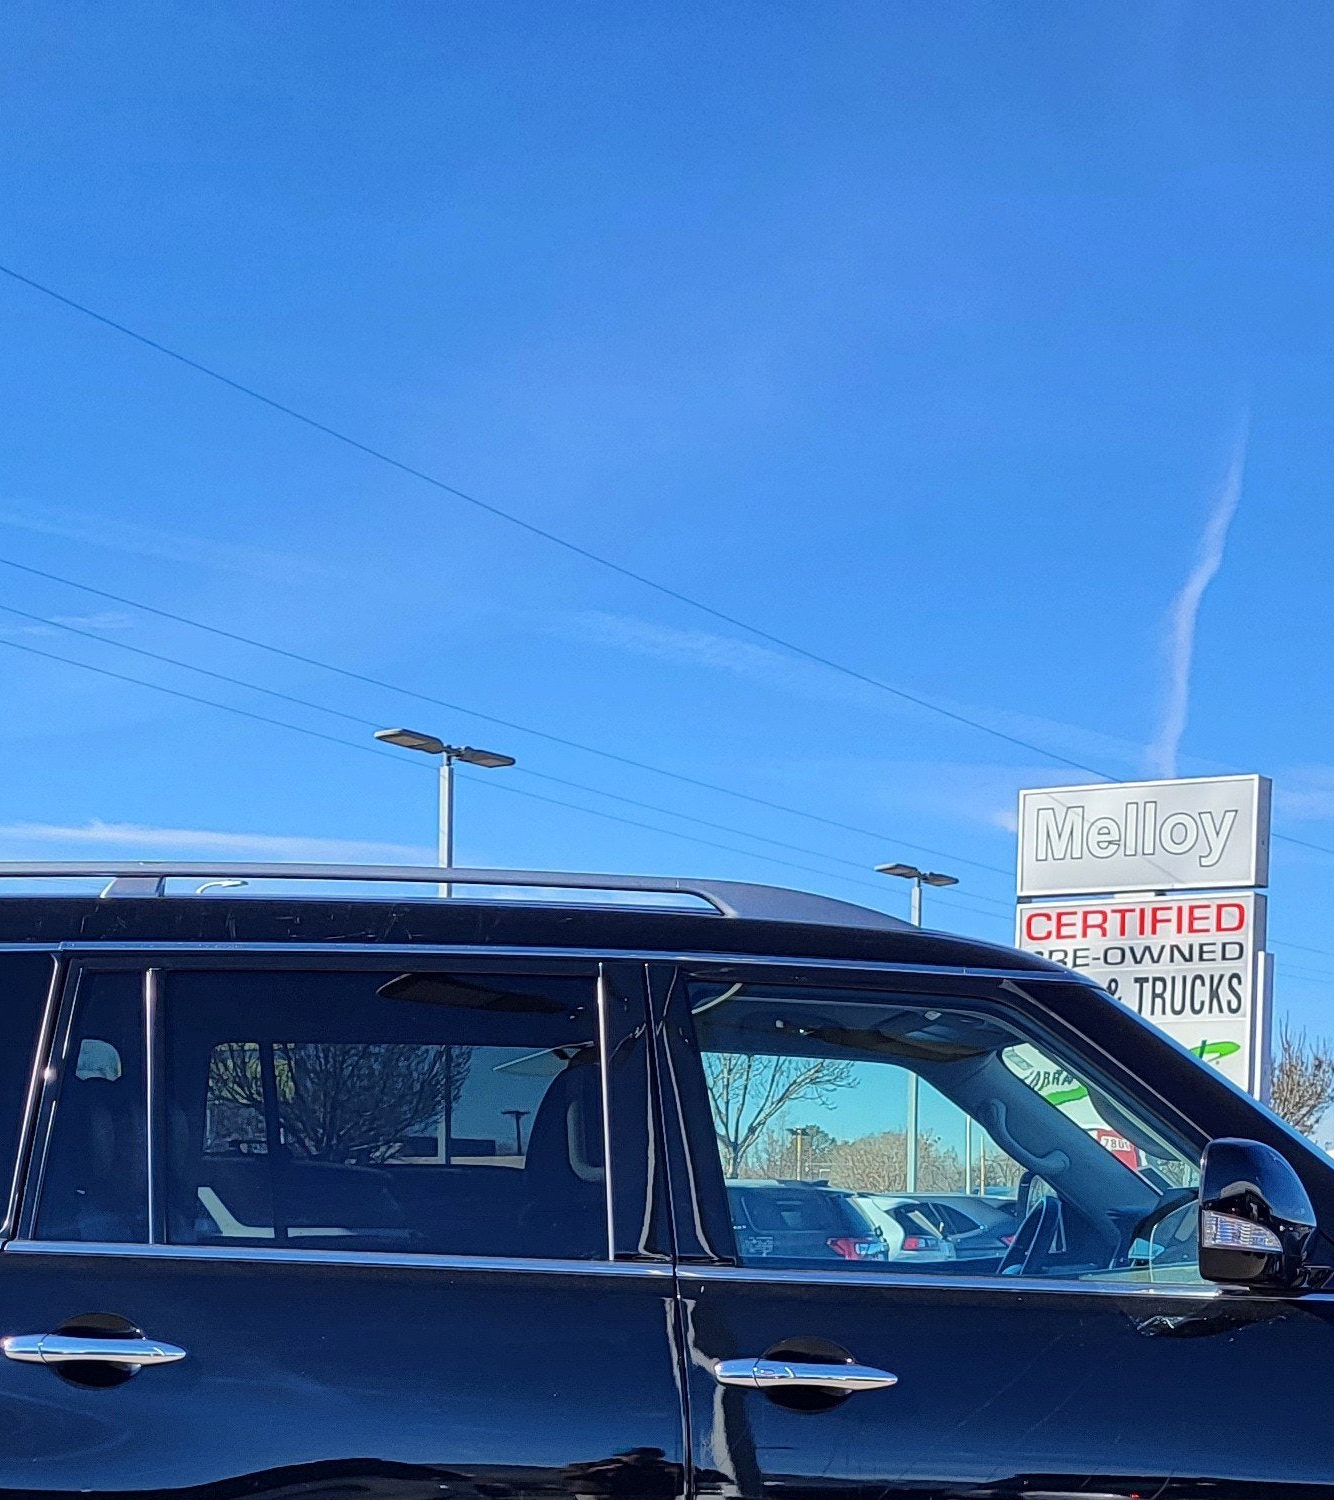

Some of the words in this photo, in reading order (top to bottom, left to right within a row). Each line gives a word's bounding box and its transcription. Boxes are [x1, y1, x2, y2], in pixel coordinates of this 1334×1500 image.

[1035, 801, 1237, 867] Melloy
[1025, 902, 1245, 941] CERTIFIED
[1133, 972, 1242, 1016] TRUCKS
